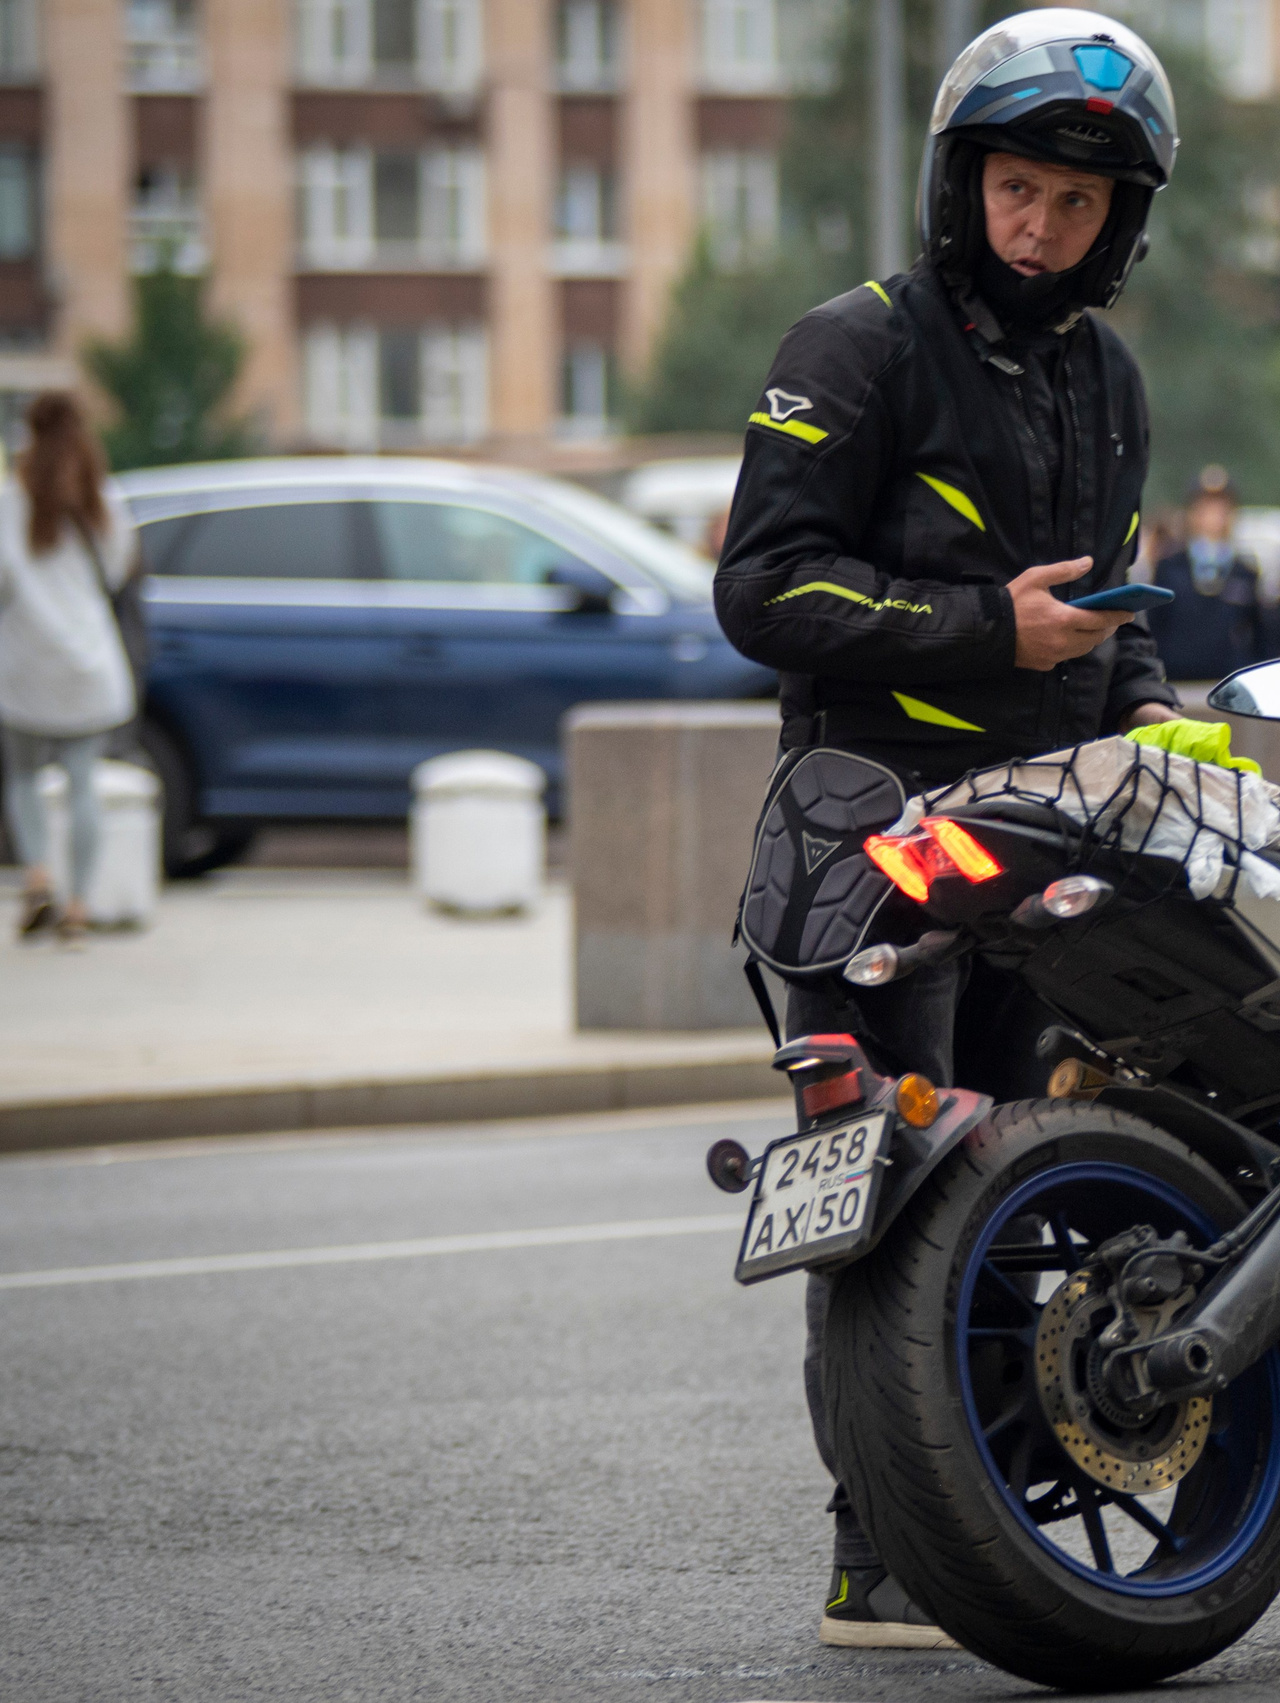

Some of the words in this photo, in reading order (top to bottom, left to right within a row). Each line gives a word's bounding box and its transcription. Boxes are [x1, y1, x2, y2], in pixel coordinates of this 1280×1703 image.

[860, 598, 933, 615] MACNA
[775, 1126, 868, 1191] 2458
[817, 1174, 846, 1192] RUS
[750, 1201, 809, 1256] AX
[814, 1187, 861, 1234] 50
